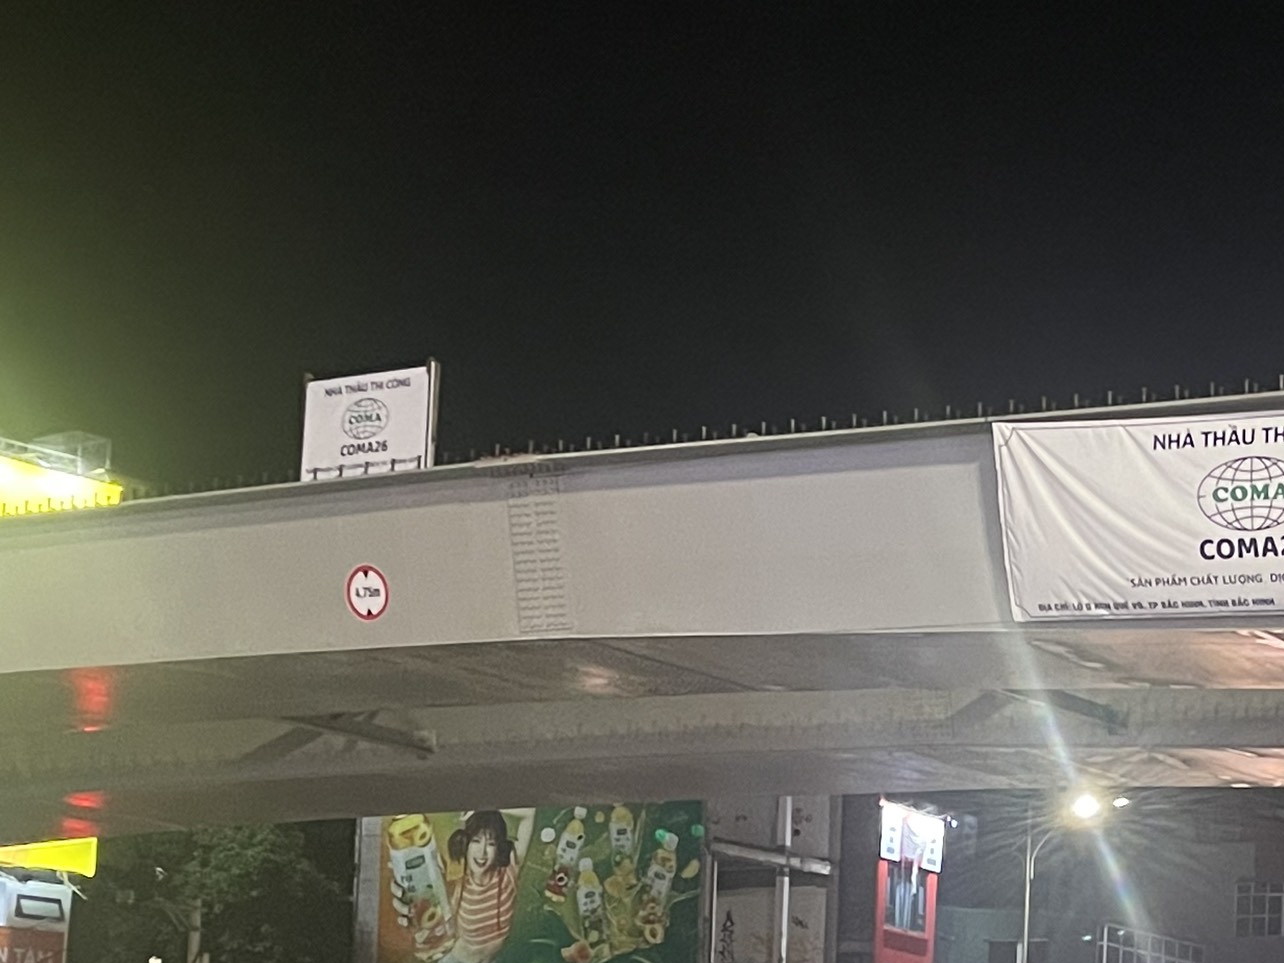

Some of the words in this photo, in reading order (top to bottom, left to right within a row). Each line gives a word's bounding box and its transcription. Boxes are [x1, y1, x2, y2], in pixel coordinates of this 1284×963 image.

[348, 412, 382, 425] COMA
[1153, 428, 1195, 450] NHÀ
[1200, 424, 1256, 448] THẦU
[340, 440, 388, 457] COMA26
